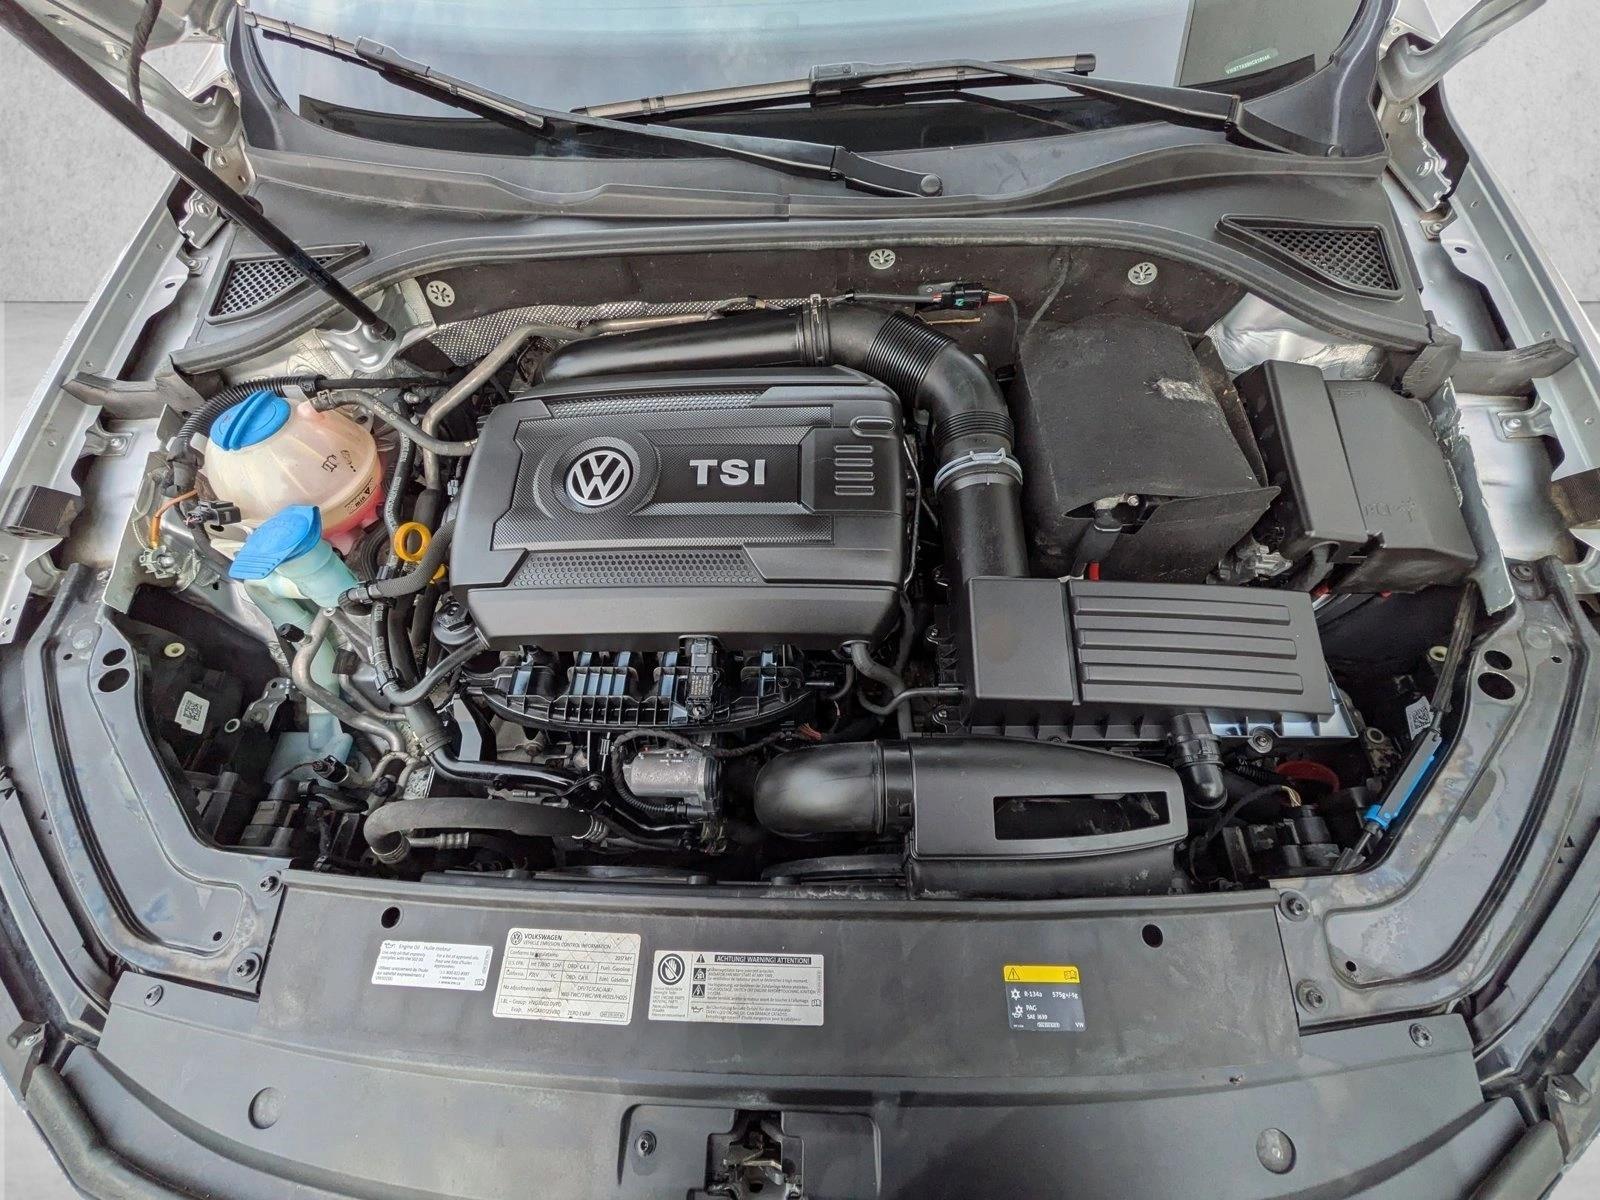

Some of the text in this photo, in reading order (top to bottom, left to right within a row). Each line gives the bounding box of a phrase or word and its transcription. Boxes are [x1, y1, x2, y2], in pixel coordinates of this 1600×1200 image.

[690, 459, 765, 485] TSI
[747, 956, 776, 964] WARNING!
[777, 957, 810, 965] ATTENTION!
